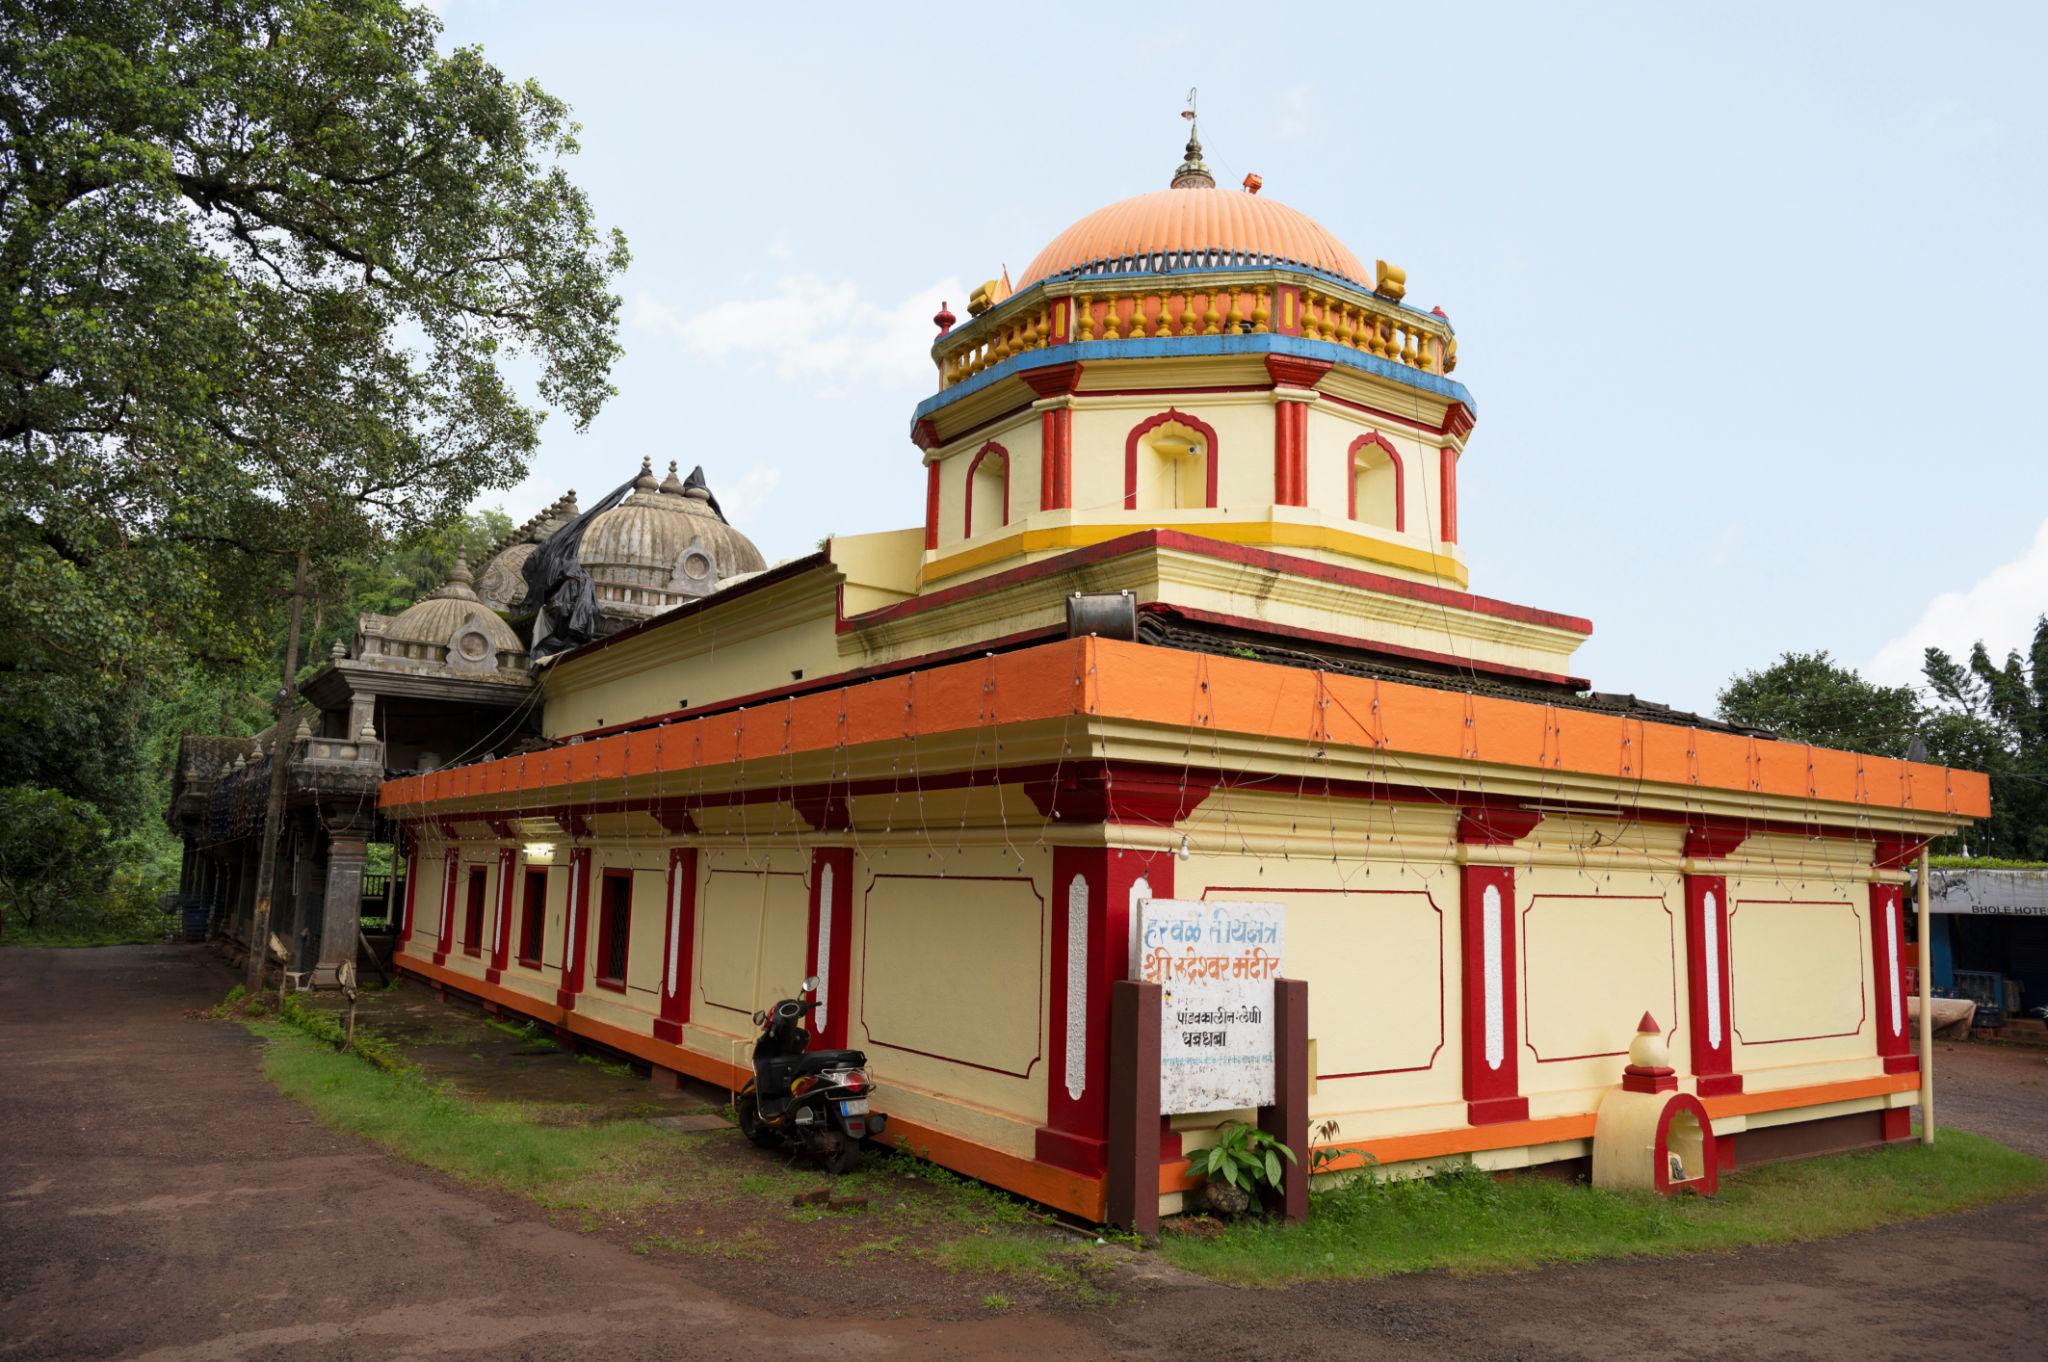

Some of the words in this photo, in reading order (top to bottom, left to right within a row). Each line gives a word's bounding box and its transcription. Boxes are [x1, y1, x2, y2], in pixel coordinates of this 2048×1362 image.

[1971, 905, 2012, 914] BHOLE
[2014, 906, 2048, 916] HOTE
[1143, 946, 1173, 982] श्री
[1232, 947, 1281, 983] मंदीर
